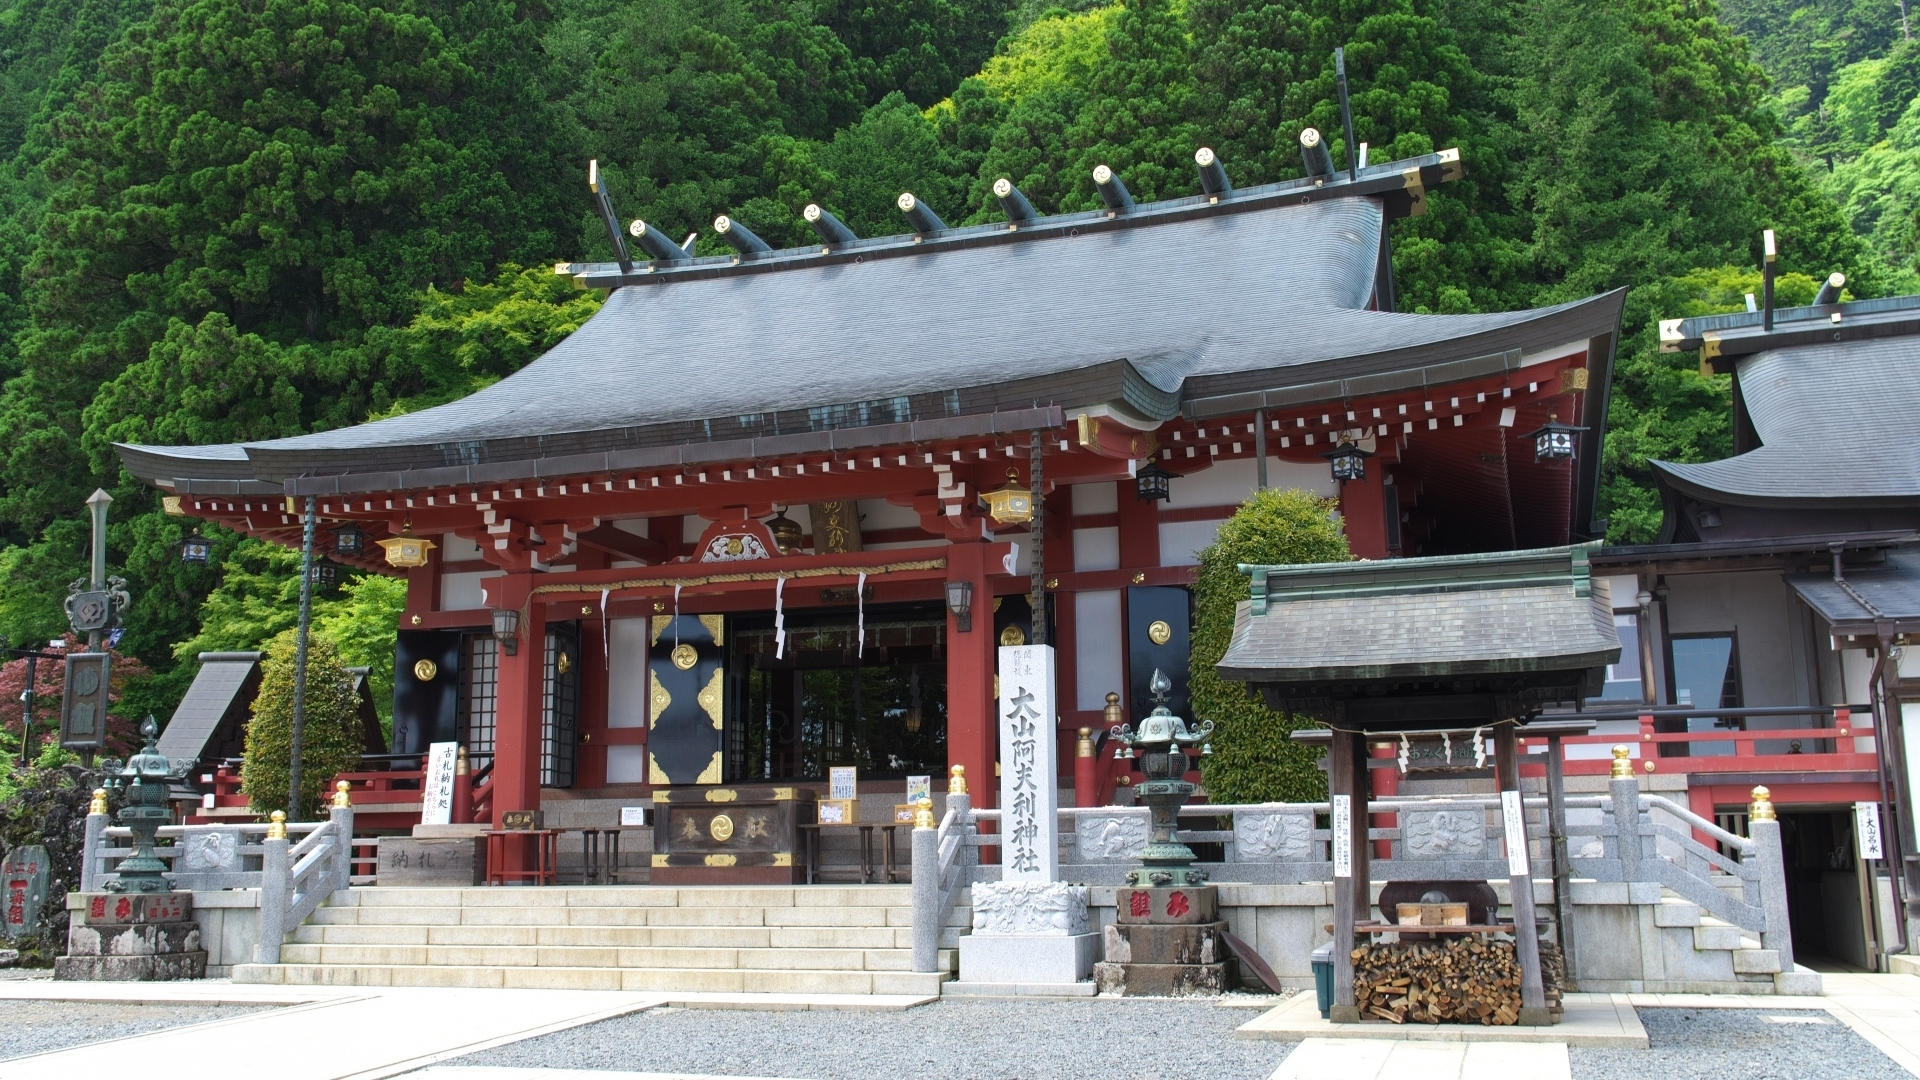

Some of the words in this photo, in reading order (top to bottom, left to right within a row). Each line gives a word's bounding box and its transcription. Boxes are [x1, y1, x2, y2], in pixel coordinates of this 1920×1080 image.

[438, 746, 453, 809] 古札納札処
[1006, 685, 1041, 873] 大山阿夫利神社
[1866, 817, 1879, 854] 大山名水
